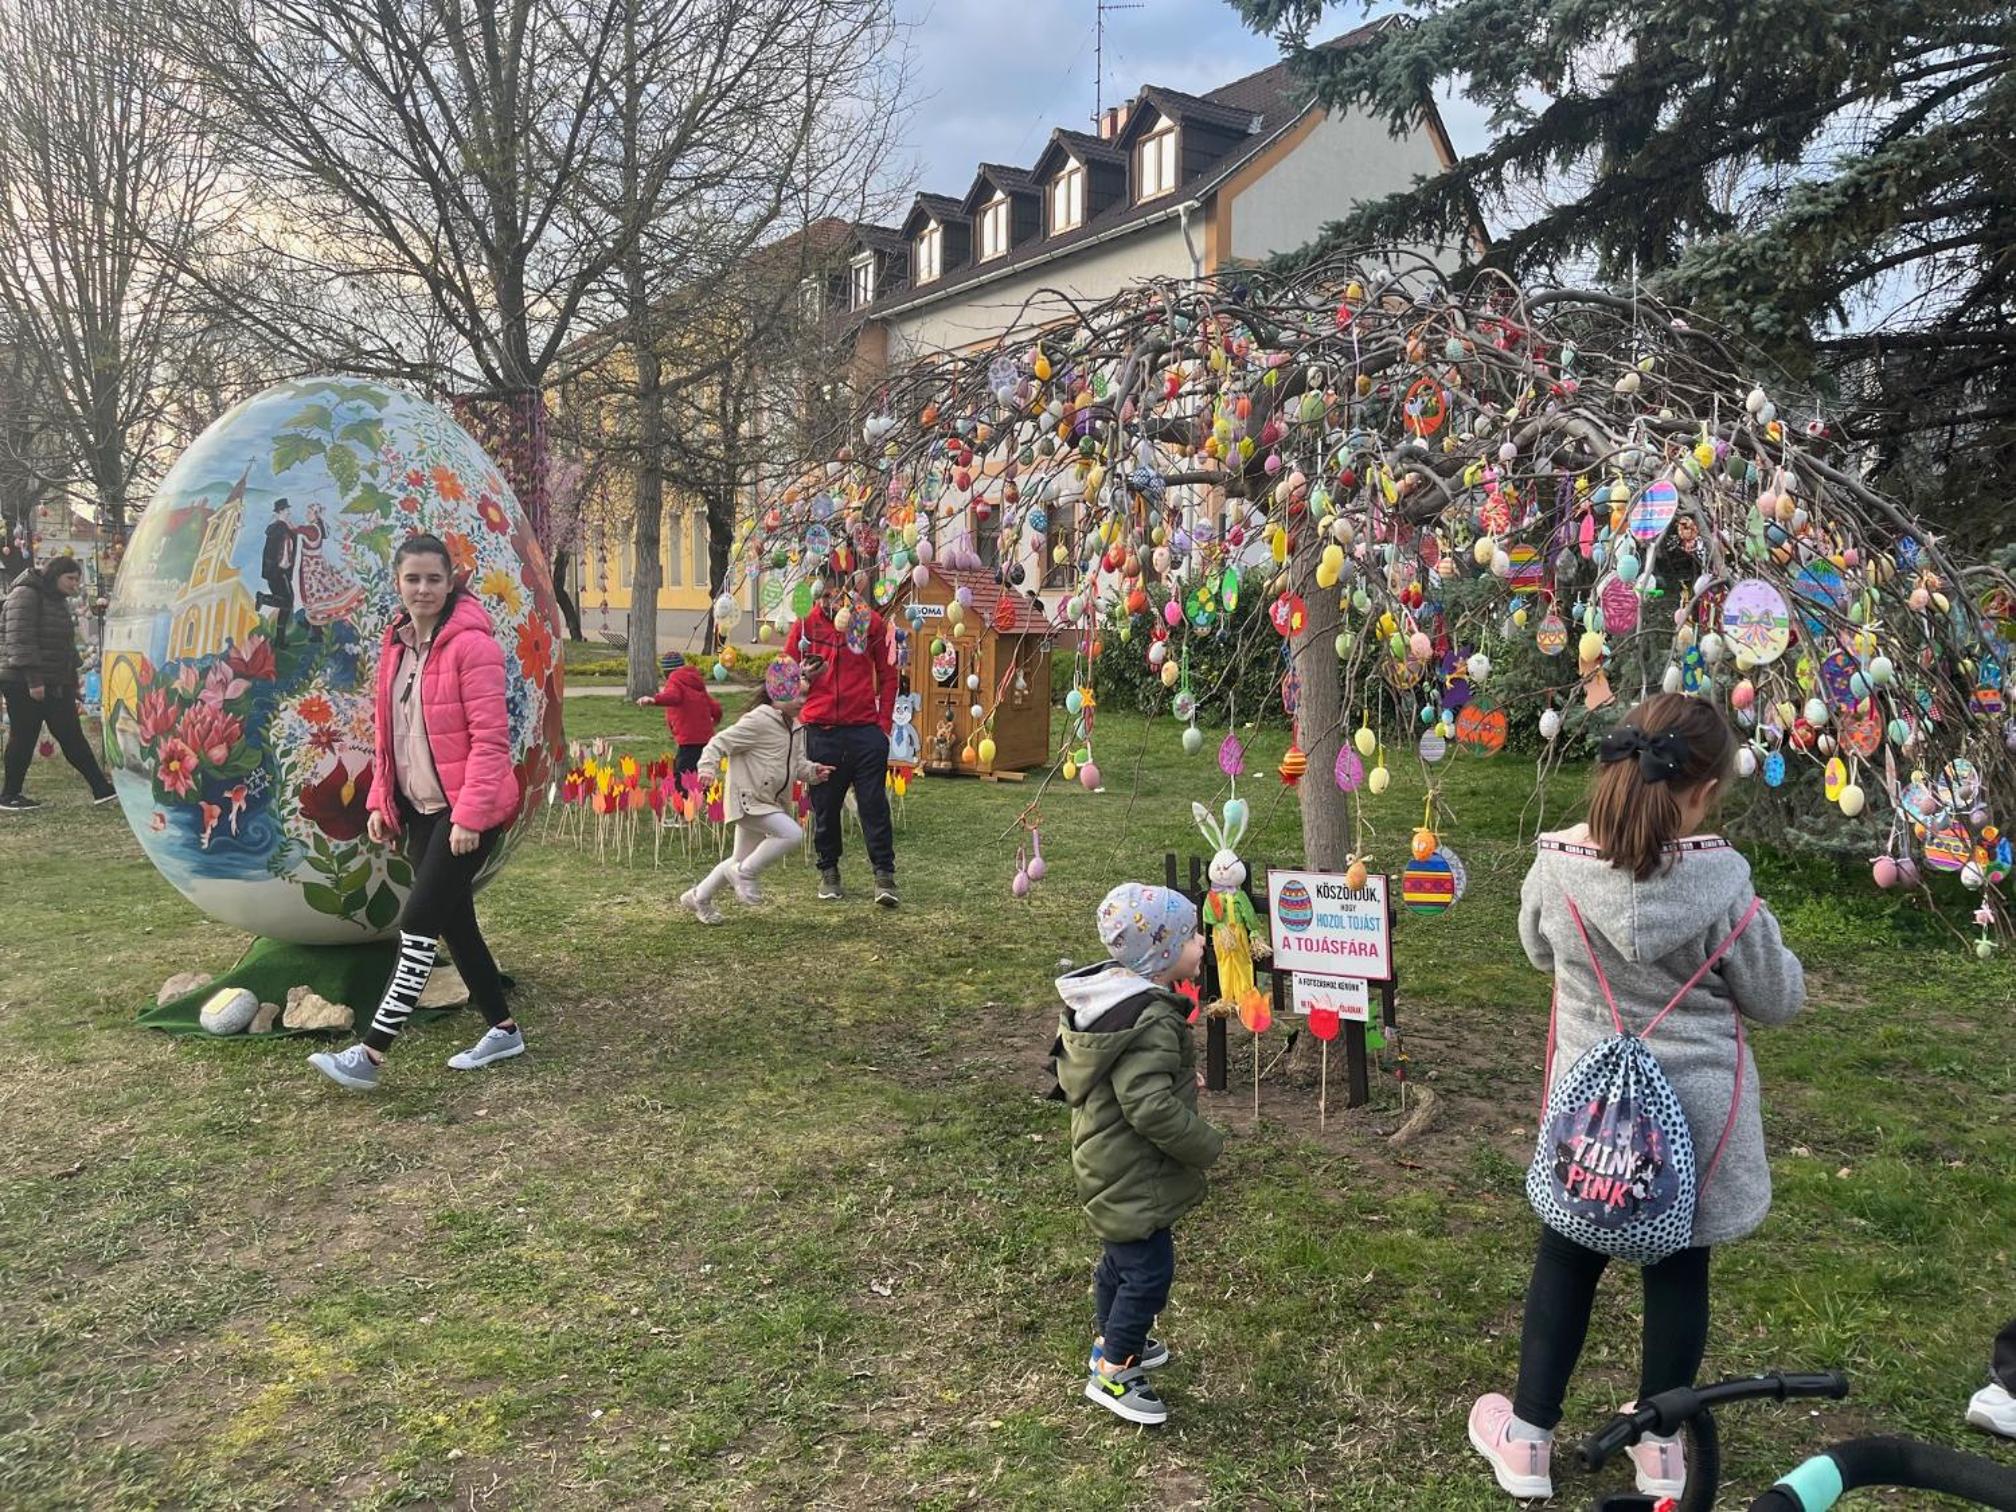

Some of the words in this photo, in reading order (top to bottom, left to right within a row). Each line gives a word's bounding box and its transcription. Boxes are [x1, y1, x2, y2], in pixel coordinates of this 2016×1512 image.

[1316, 913, 1346, 929] HOZOL
[1347, 913, 1381, 932] TOJÁST
[1282, 936, 1291, 950] A
[1295, 936, 1379, 957] TOJÁSFÁRA
[1565, 1162, 1629, 1208] PINK
